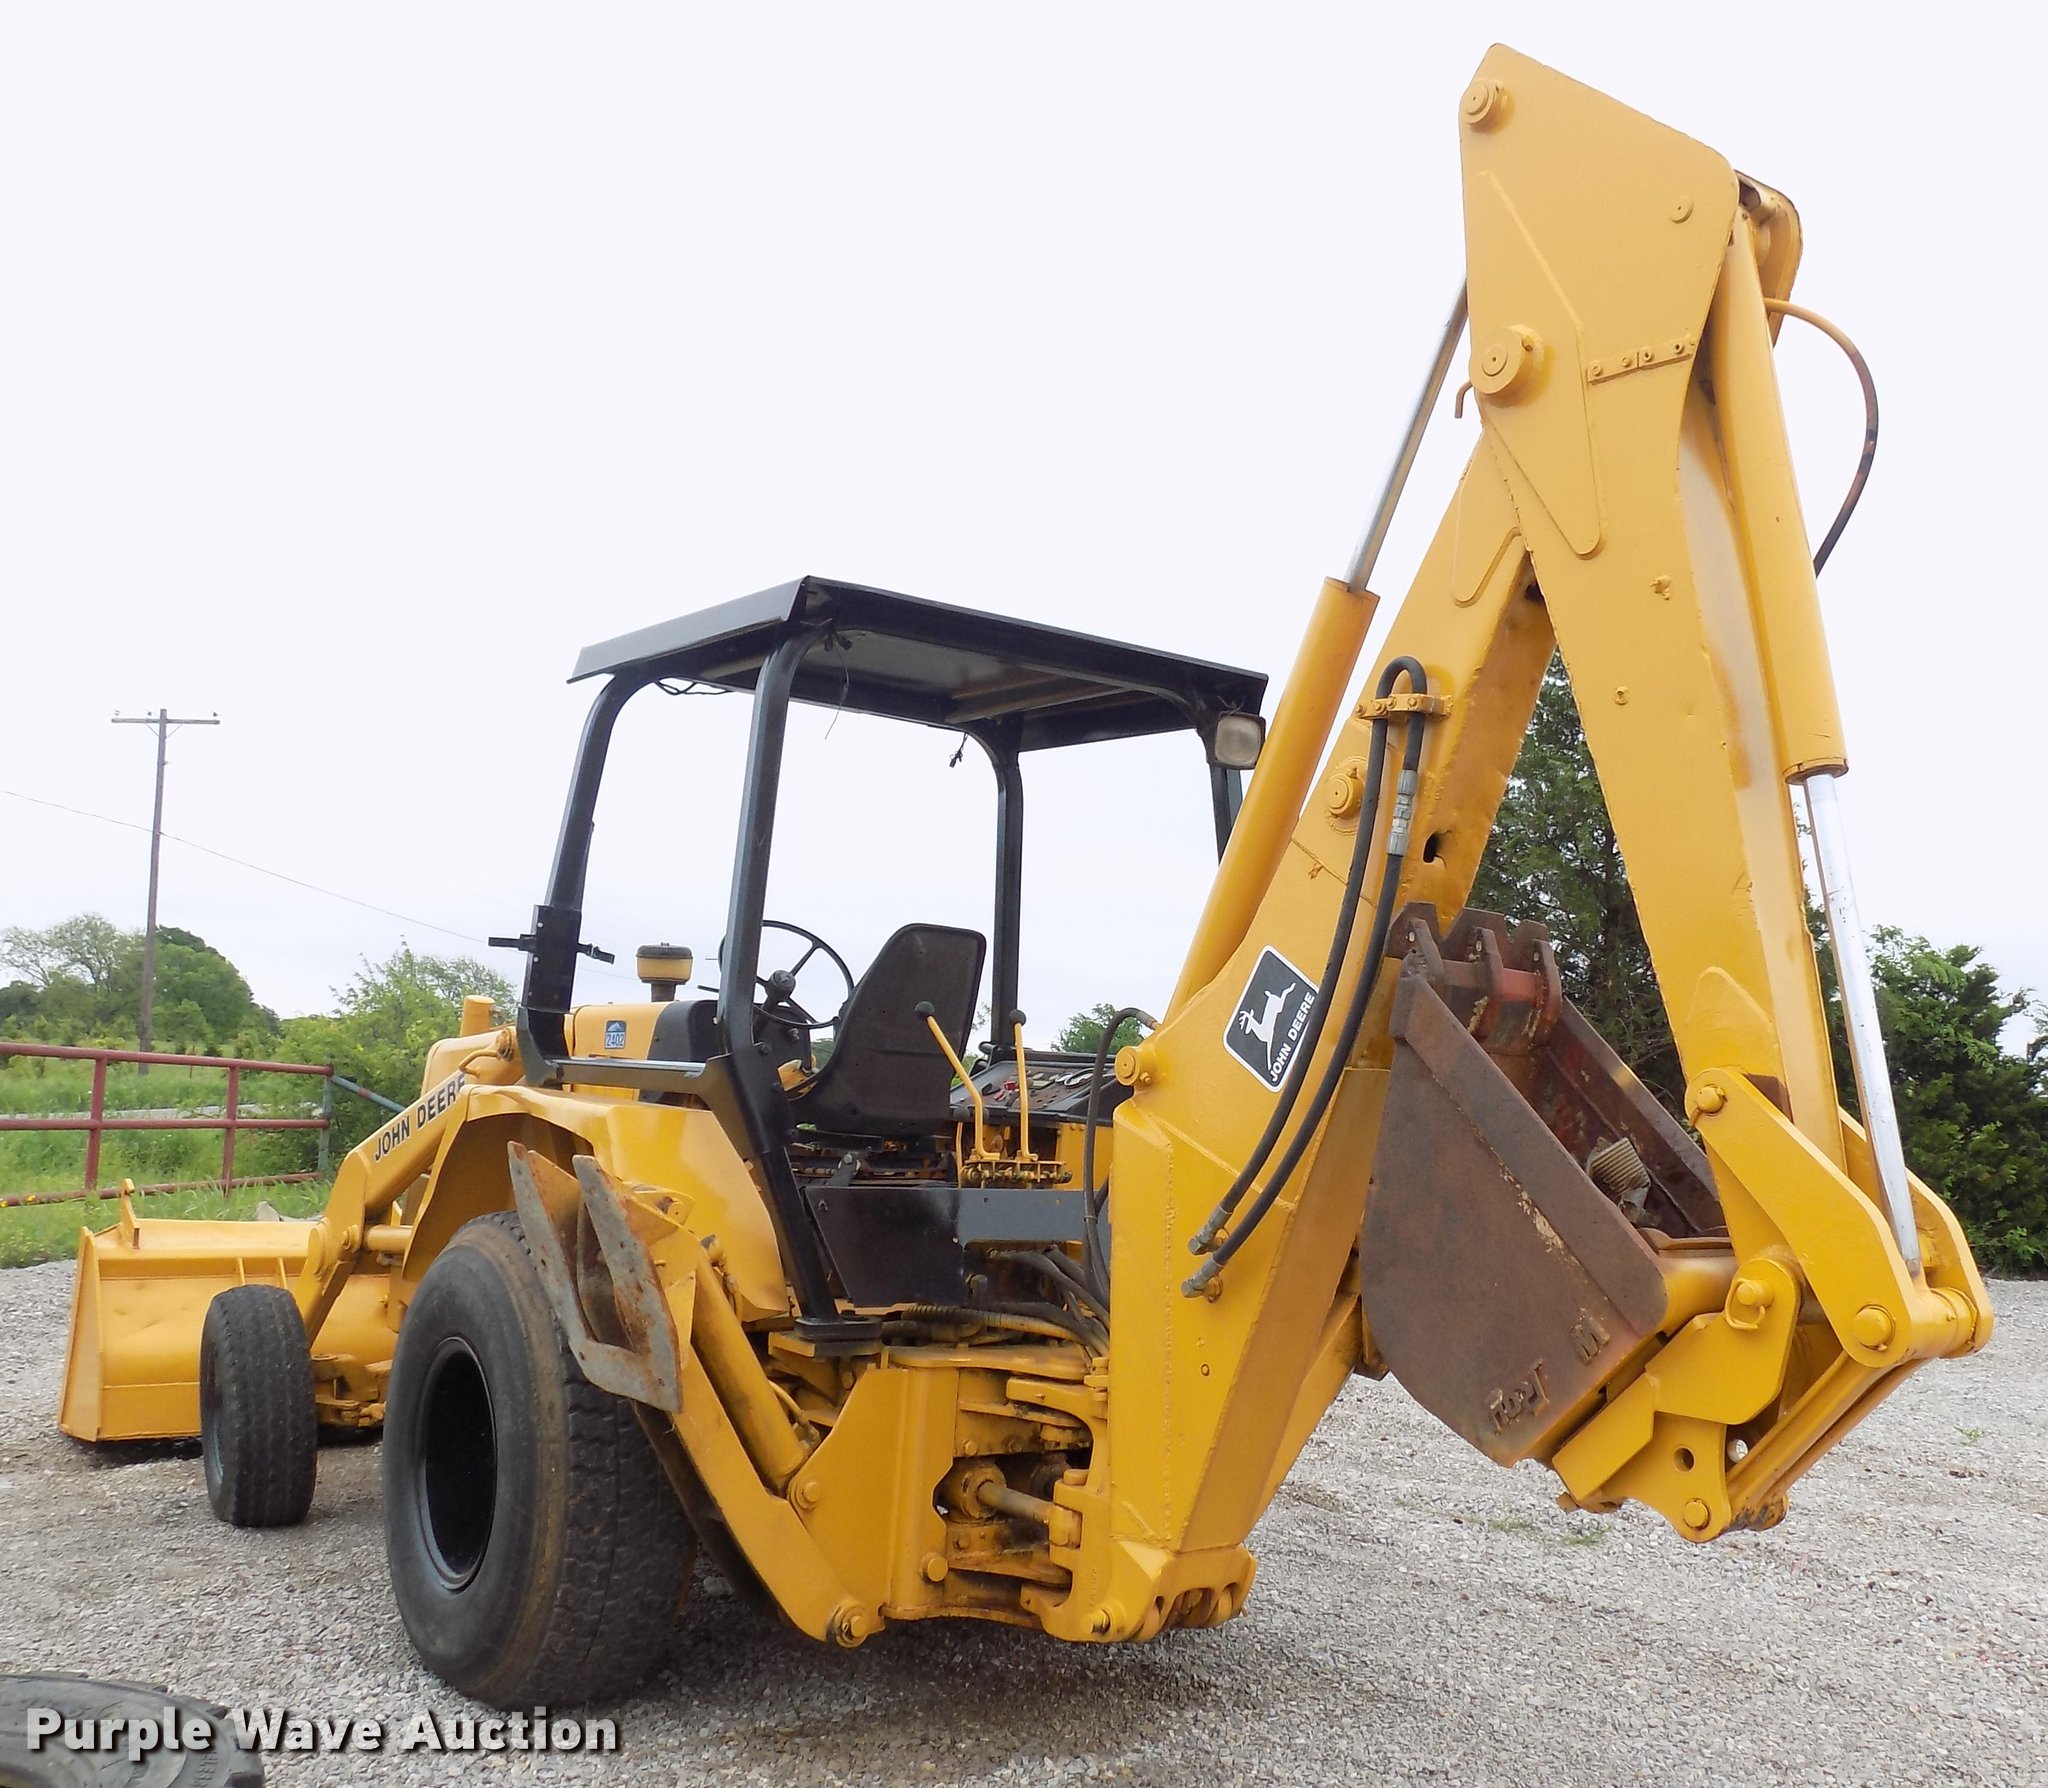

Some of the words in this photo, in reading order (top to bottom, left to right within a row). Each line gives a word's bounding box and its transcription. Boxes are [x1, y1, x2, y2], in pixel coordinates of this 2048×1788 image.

[607, 1033, 625, 1047] 2402
[1269, 1043, 1292, 1082] JOHN
[1287, 991, 1315, 1041] DEERE
[375, 1116, 410, 1161] JOHN
